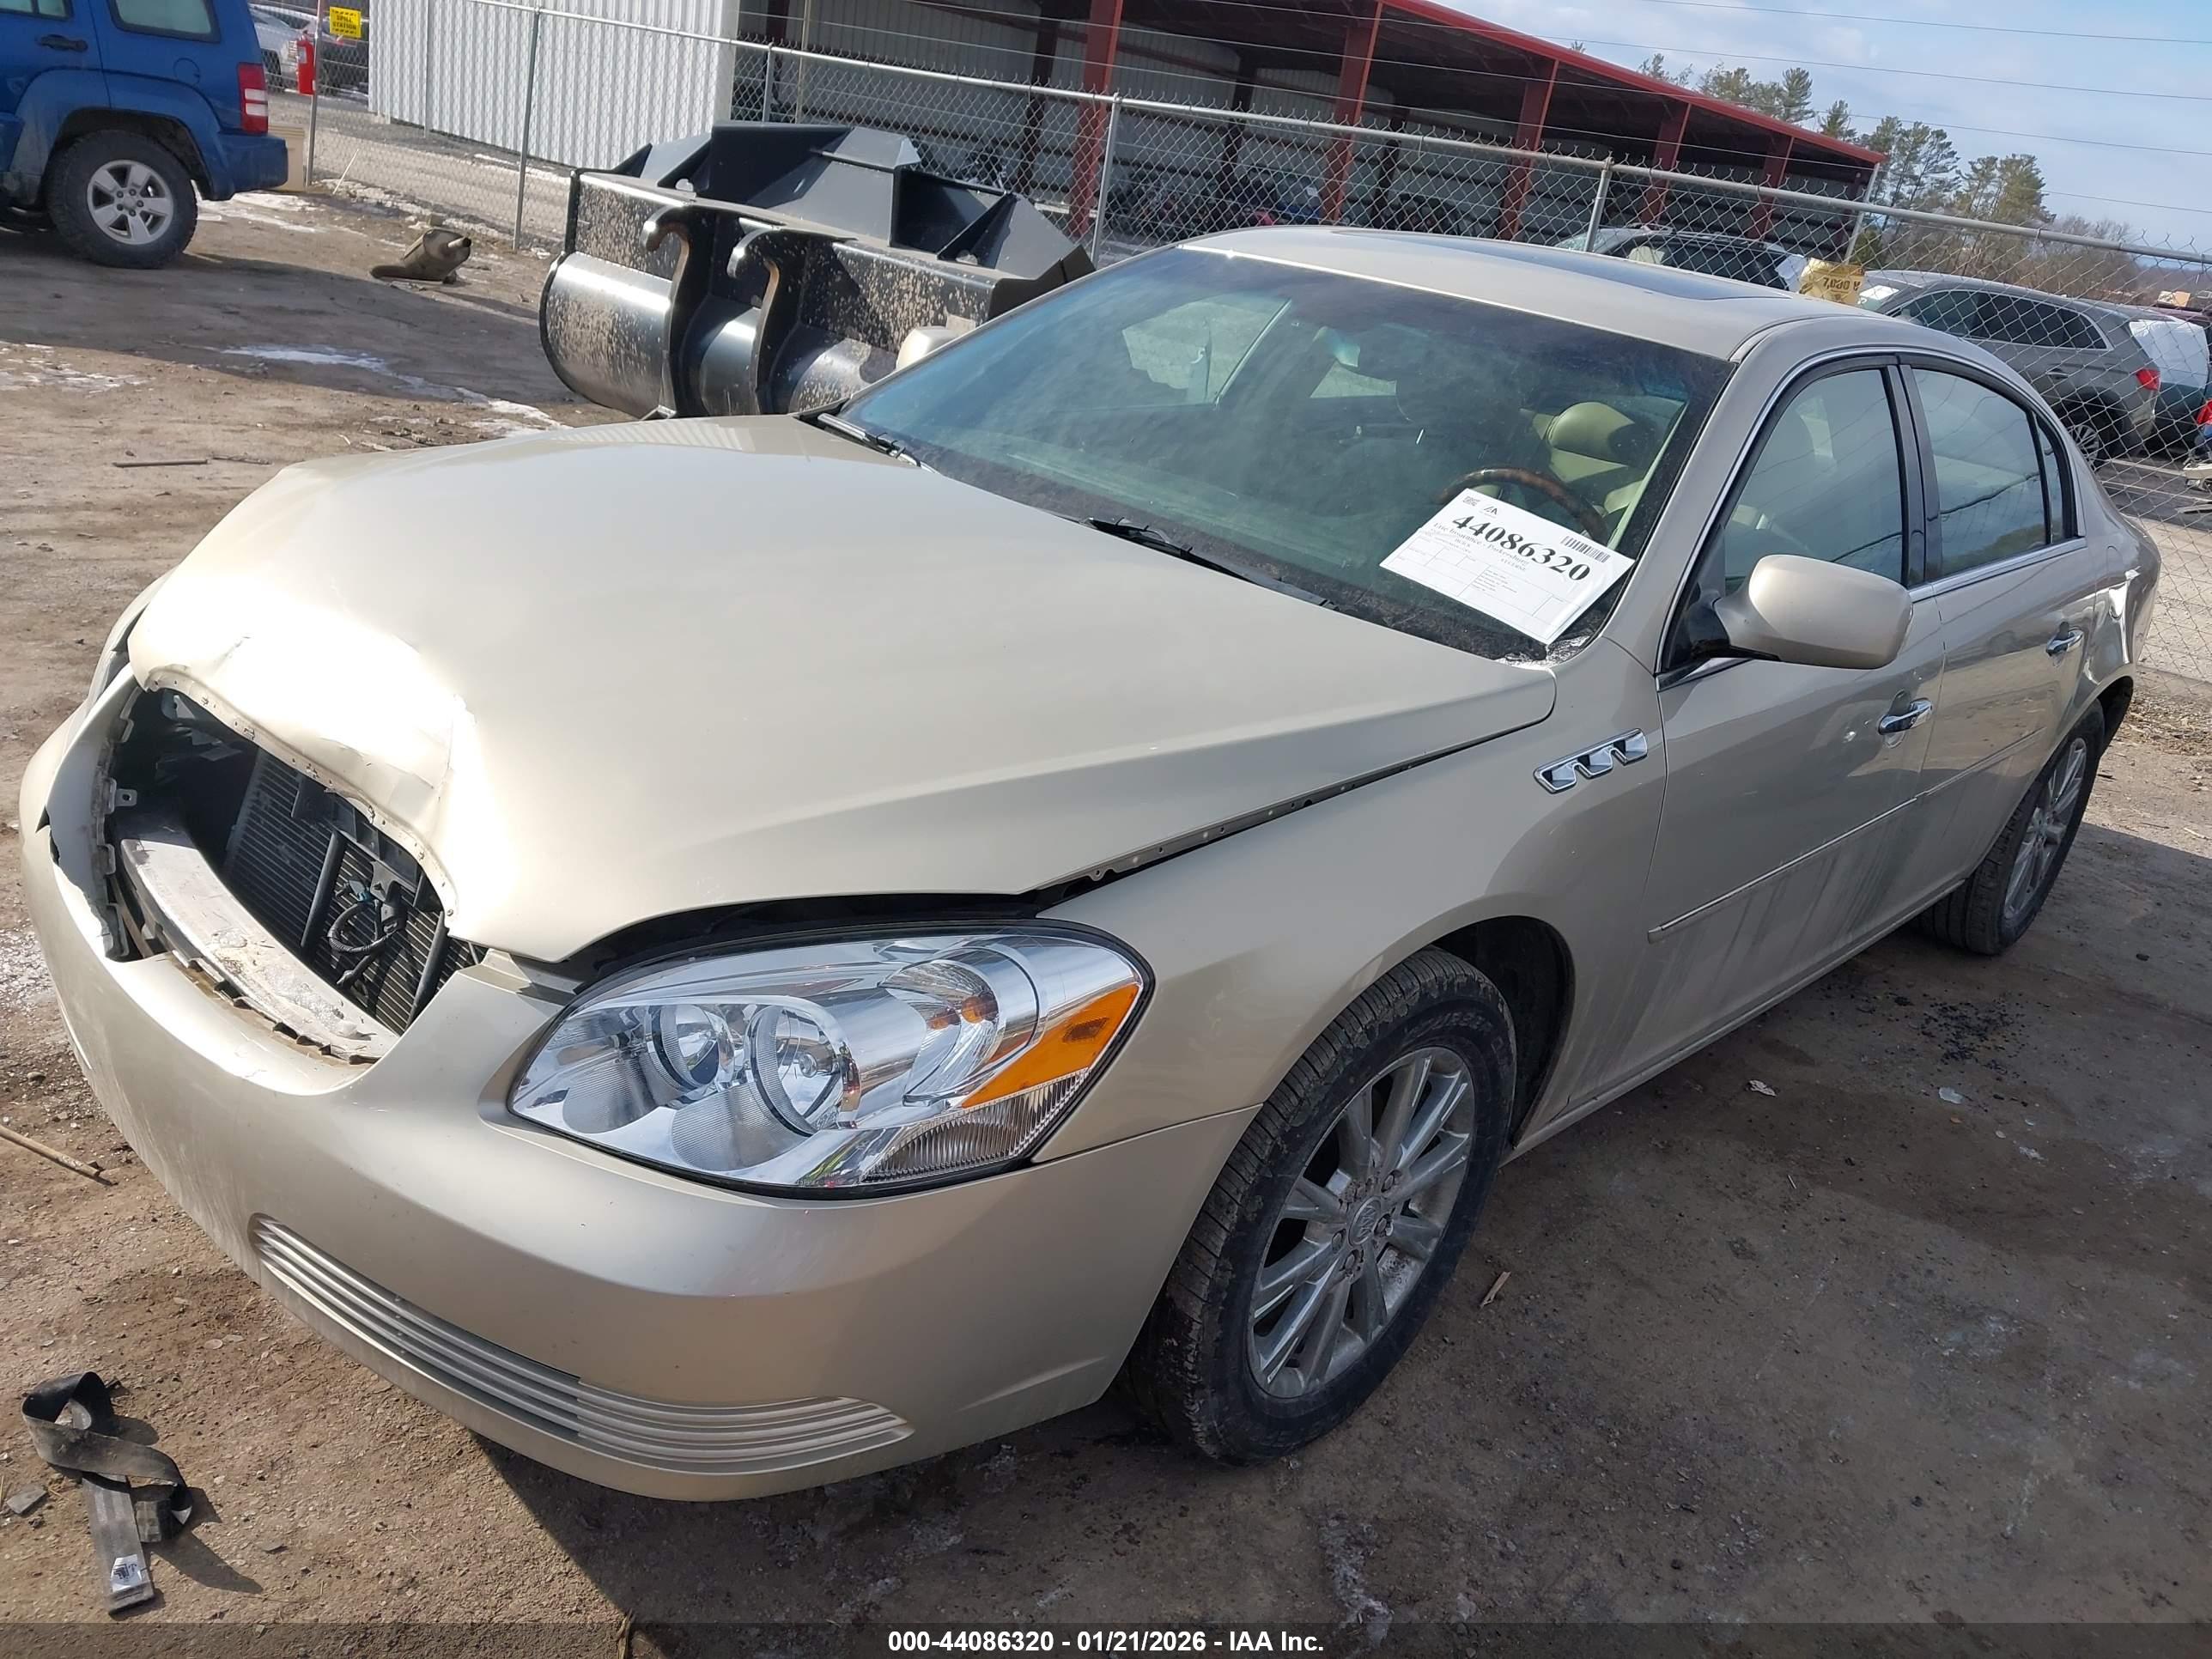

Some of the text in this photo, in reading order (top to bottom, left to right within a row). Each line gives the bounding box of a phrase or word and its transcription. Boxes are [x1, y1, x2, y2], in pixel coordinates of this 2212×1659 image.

[336, 15, 353, 23] SPILL
[332, 21, 357, 30] STATION
[1452, 515, 1591, 581] 44086320
